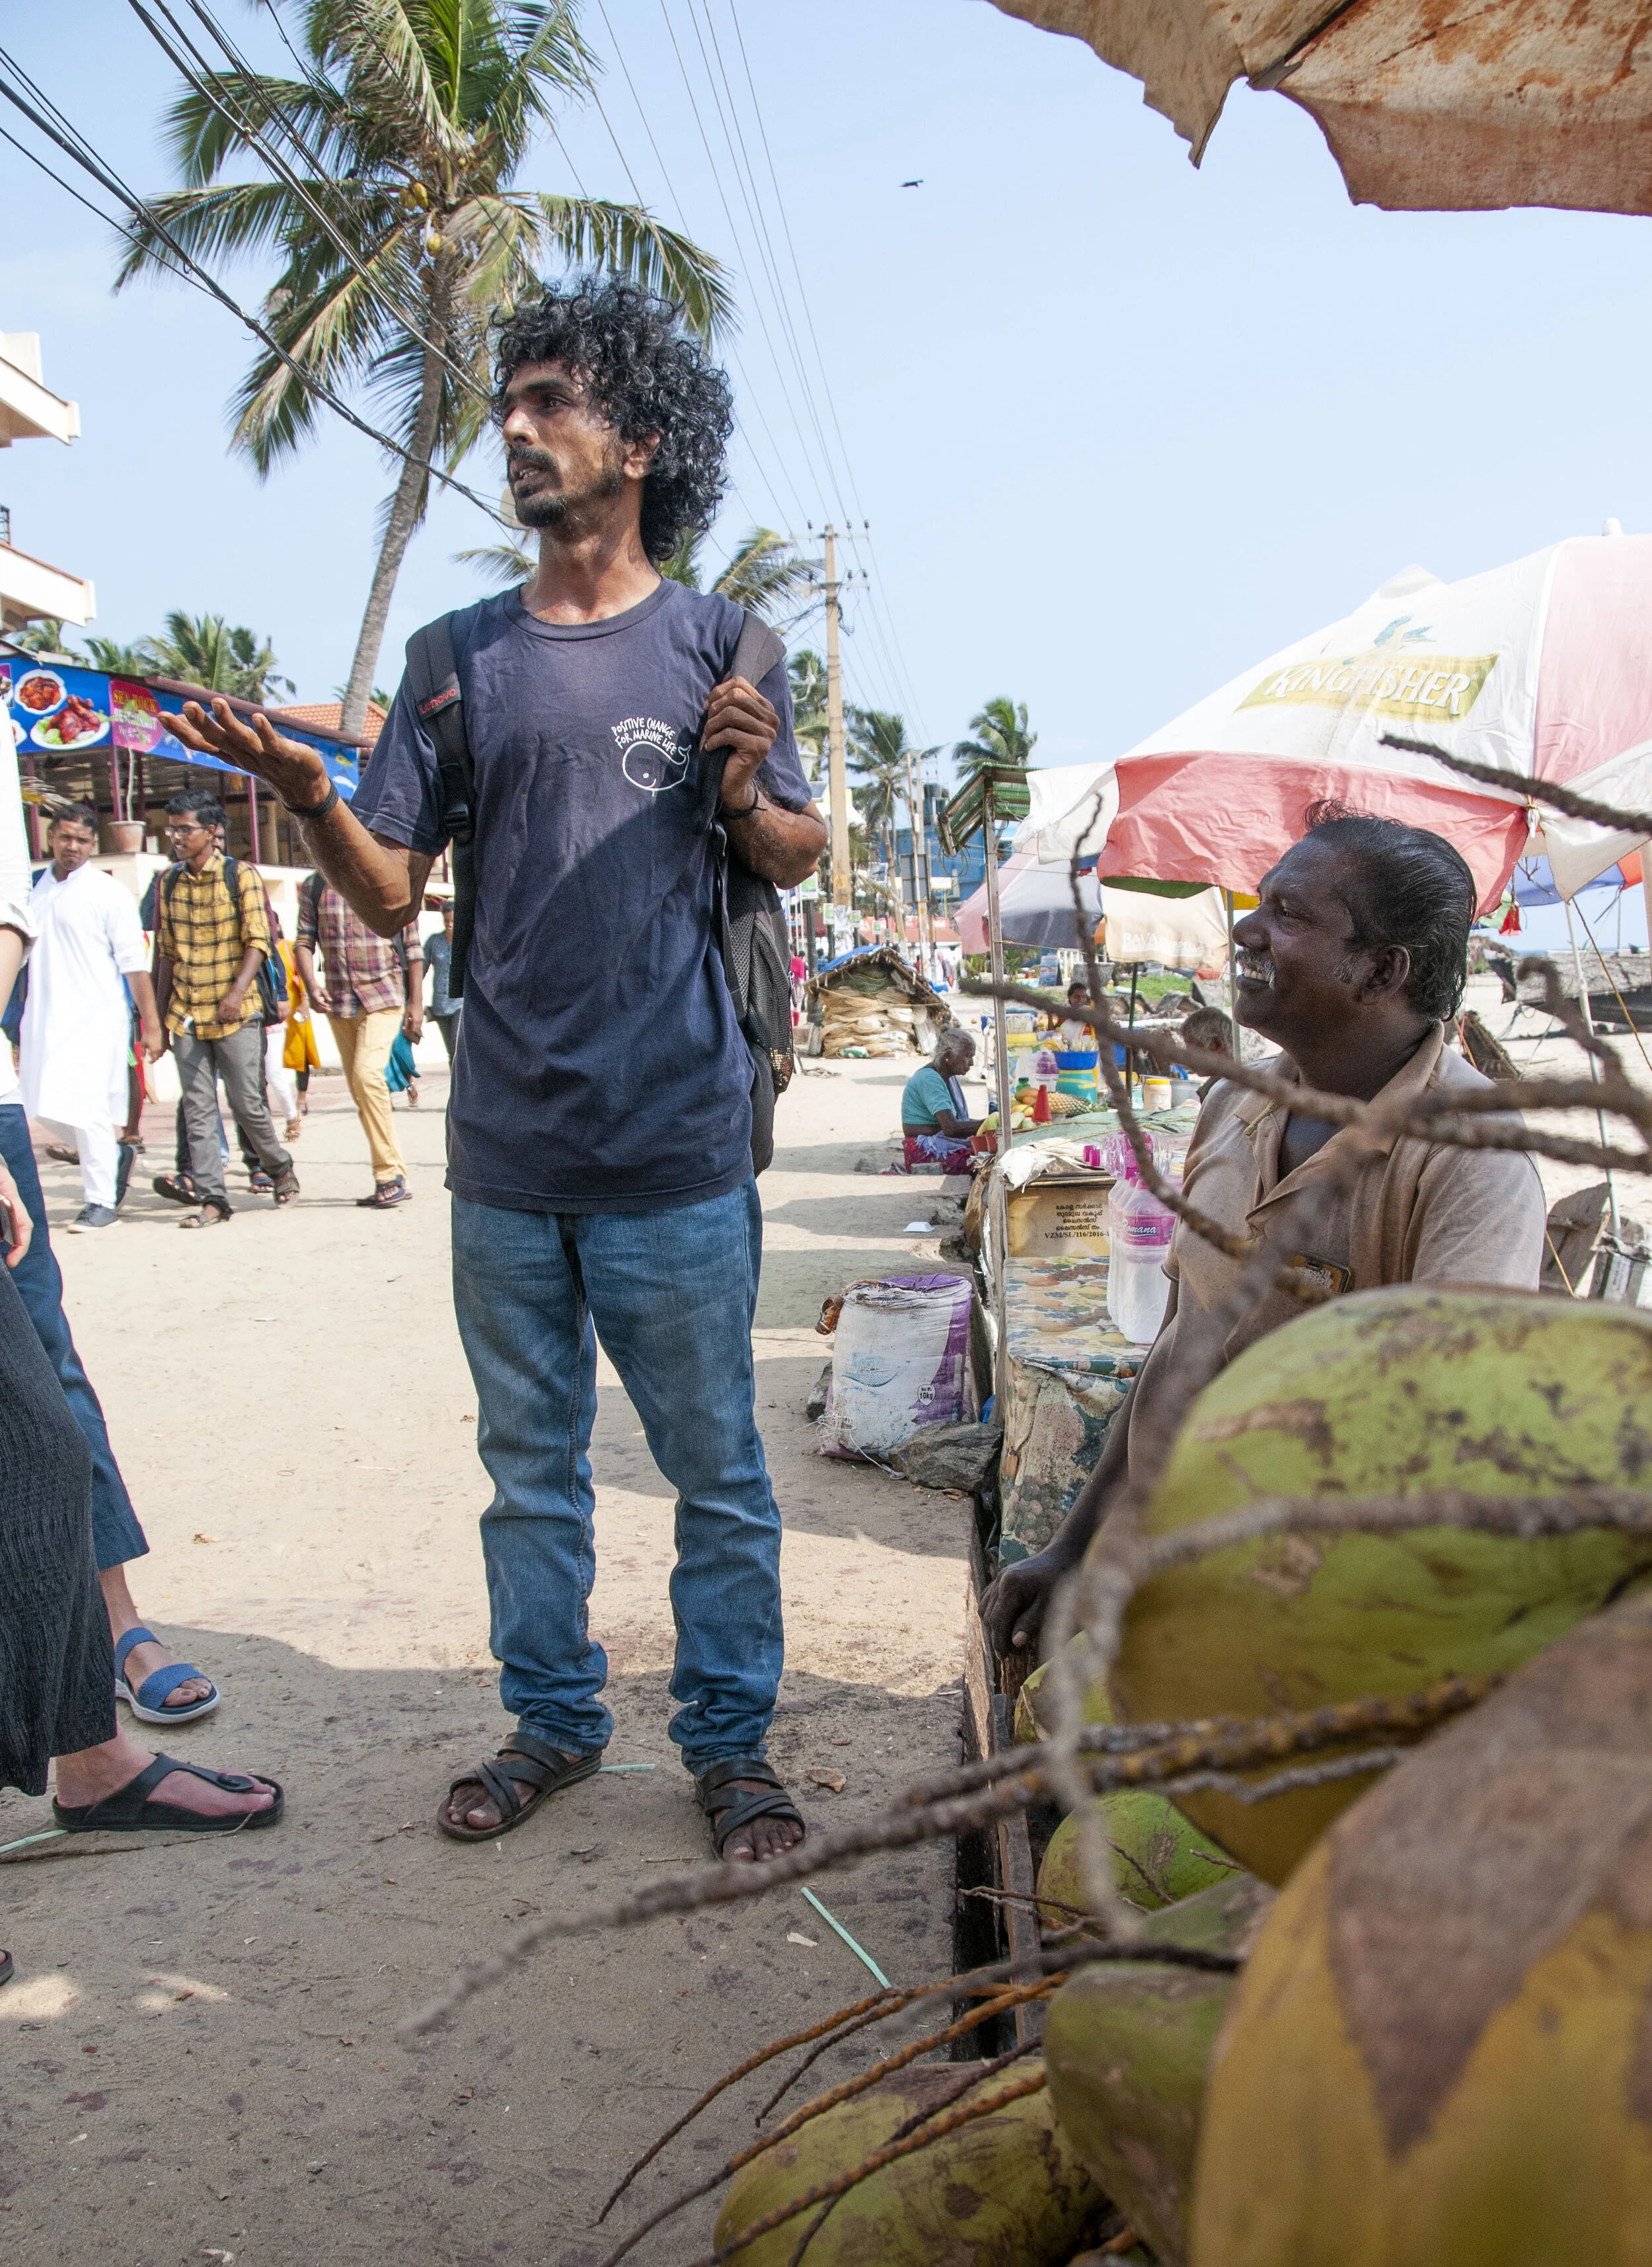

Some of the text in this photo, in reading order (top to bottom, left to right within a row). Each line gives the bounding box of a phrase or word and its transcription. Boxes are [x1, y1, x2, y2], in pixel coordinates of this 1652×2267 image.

[418, 688, 457, 714] Lenovo
[1263, 664, 1472, 716] KINGFISHER
[611, 717, 675, 739] POSITIVE CHANGE
[615, 729, 677, 755] FOR MARINE LIFE
